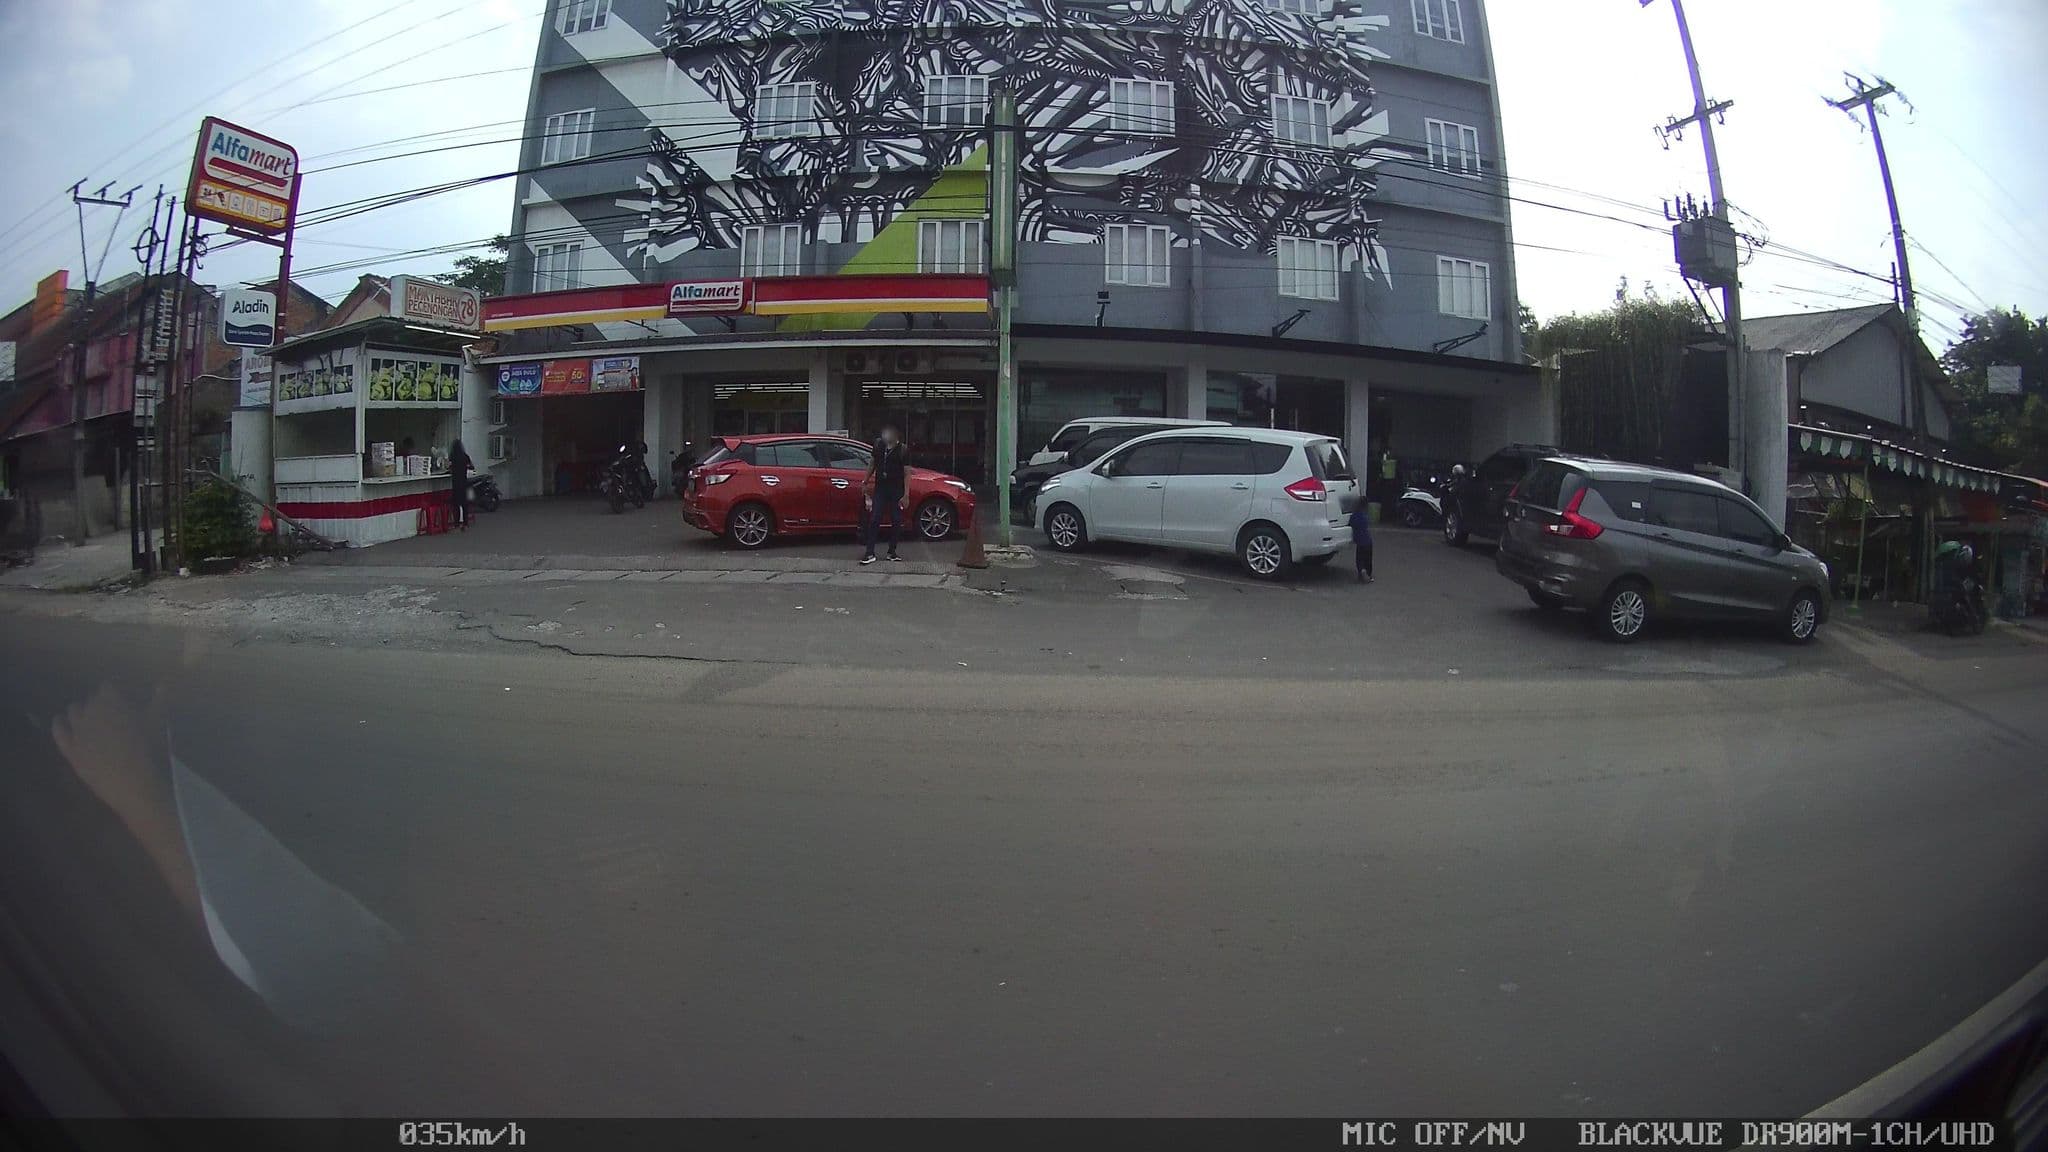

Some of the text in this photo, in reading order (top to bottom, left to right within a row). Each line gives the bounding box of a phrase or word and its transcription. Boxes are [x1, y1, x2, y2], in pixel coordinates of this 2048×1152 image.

[211, 131, 292, 175] Alfamart
[673, 284, 740, 299] Alfamart
[232, 299, 269, 314] Aladin
[461, 298, 474, 319] 78
